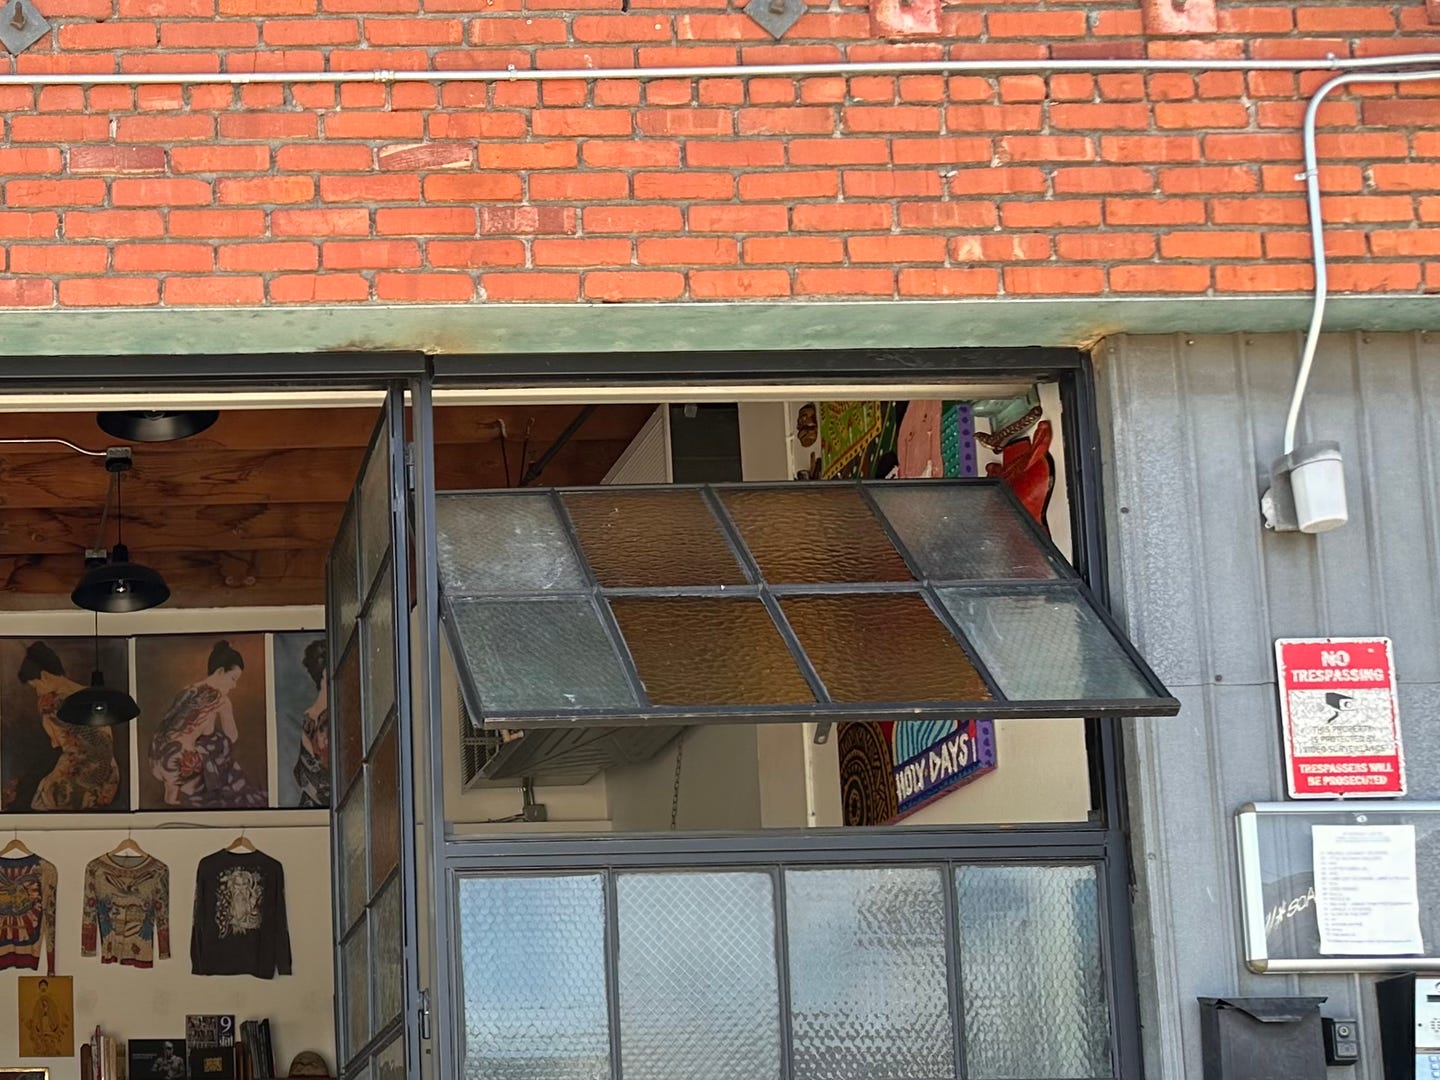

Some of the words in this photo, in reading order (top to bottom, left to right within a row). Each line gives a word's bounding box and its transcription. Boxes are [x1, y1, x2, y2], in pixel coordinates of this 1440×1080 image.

[1320, 650, 1350, 667] NO
[1291, 669, 1385, 682] TRESPASSING
[896, 758, 926, 802] HOLY
[929, 733, 969, 783] DAYS
[1299, 763, 1367, 773] TRESPASSERS
[1368, 763, 1394, 772] WILL
[1307, 777, 1322, 786] BE
[1323, 775, 1388, 785] PROSECUTED
[220, 1016, 231, 1033] 9
